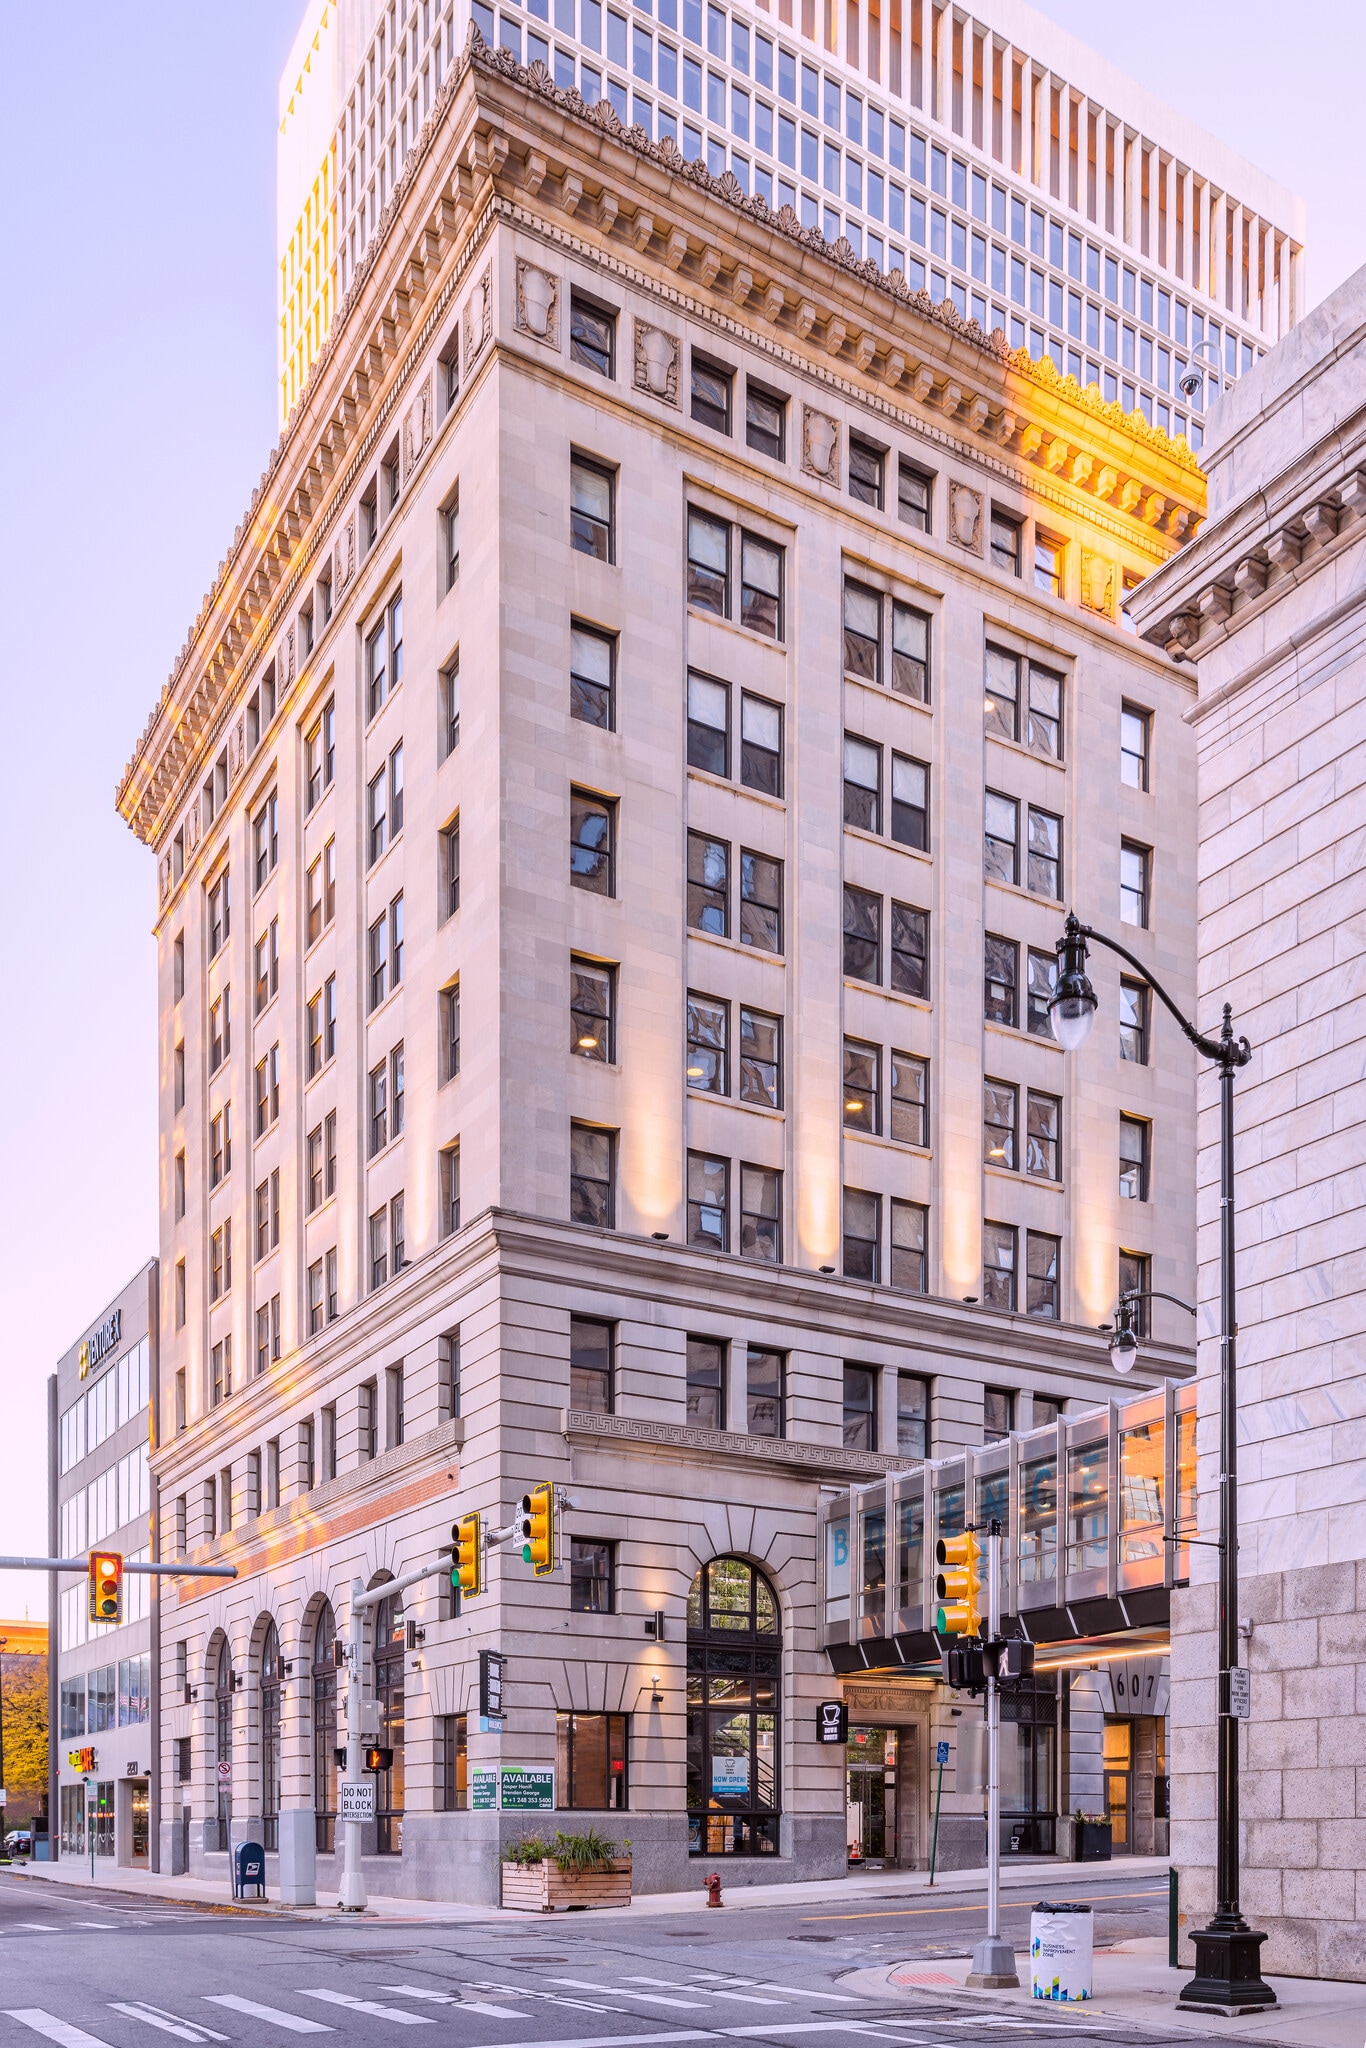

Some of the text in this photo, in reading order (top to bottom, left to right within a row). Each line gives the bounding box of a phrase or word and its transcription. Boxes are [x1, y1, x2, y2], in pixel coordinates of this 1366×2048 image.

[1117, 1673, 1154, 1698] 607
[473, 1774, 496, 1784] AVAILABLE
[503, 1774, 551, 1783] AVAILABLE
[344, 1788, 372, 1797] DO NOT
[344, 1801, 372, 1809] BLOCK
